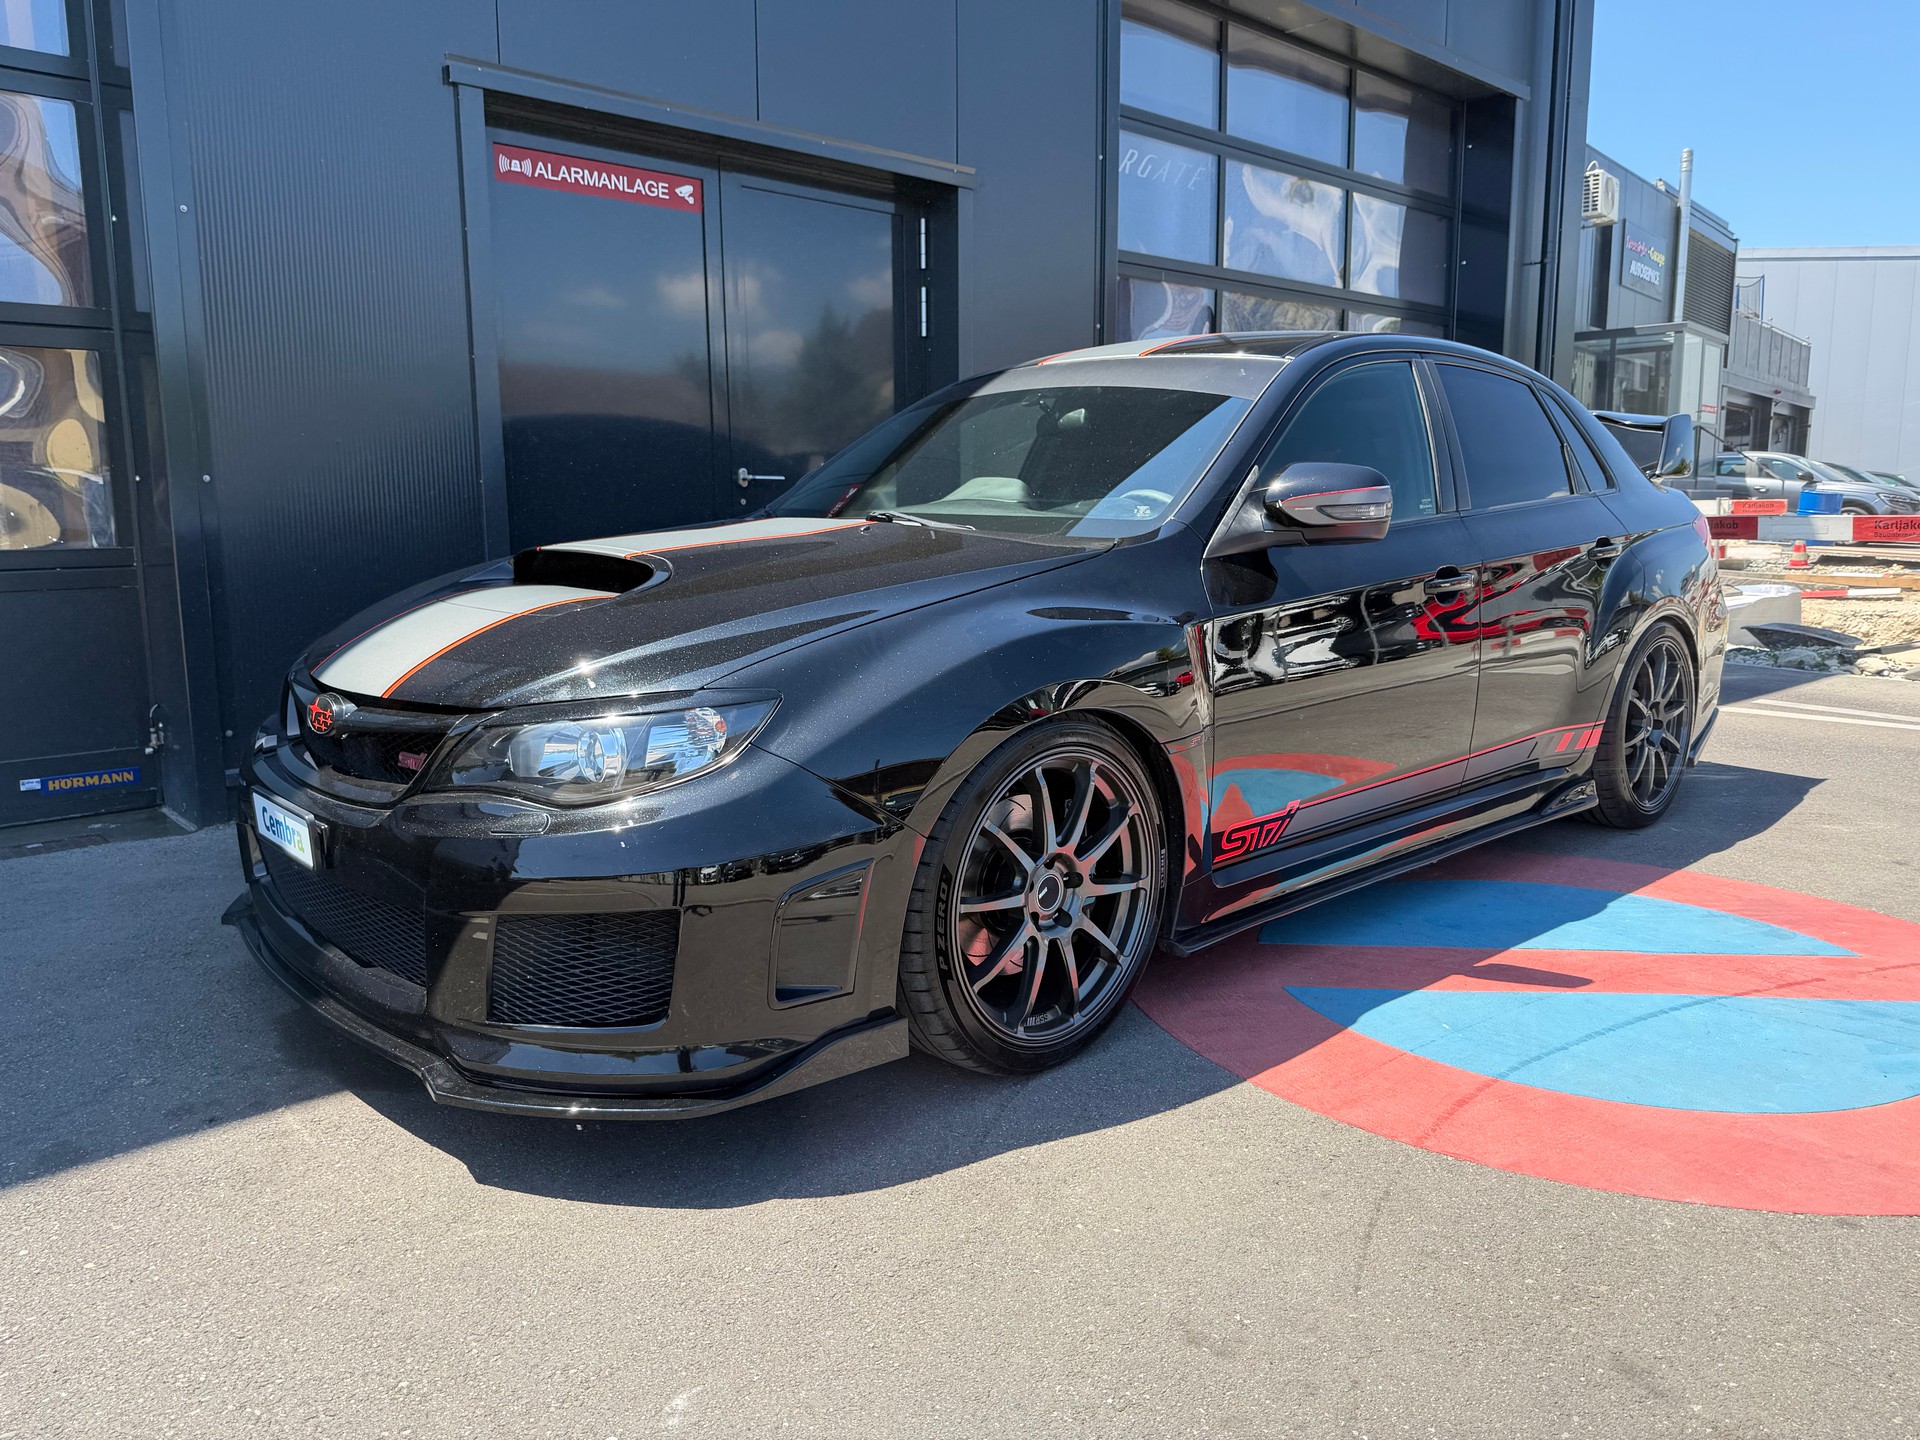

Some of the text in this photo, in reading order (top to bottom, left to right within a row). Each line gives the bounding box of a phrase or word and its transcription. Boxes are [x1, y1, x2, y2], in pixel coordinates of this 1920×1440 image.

[534, 161, 670, 200] ALARMANLAGE
[1119, 148, 1207, 191] RGATE
[48, 771, 134, 791] HÖRMANN
[262, 806, 305, 853] Cembra
[936, 880, 949, 971] P ZERO
